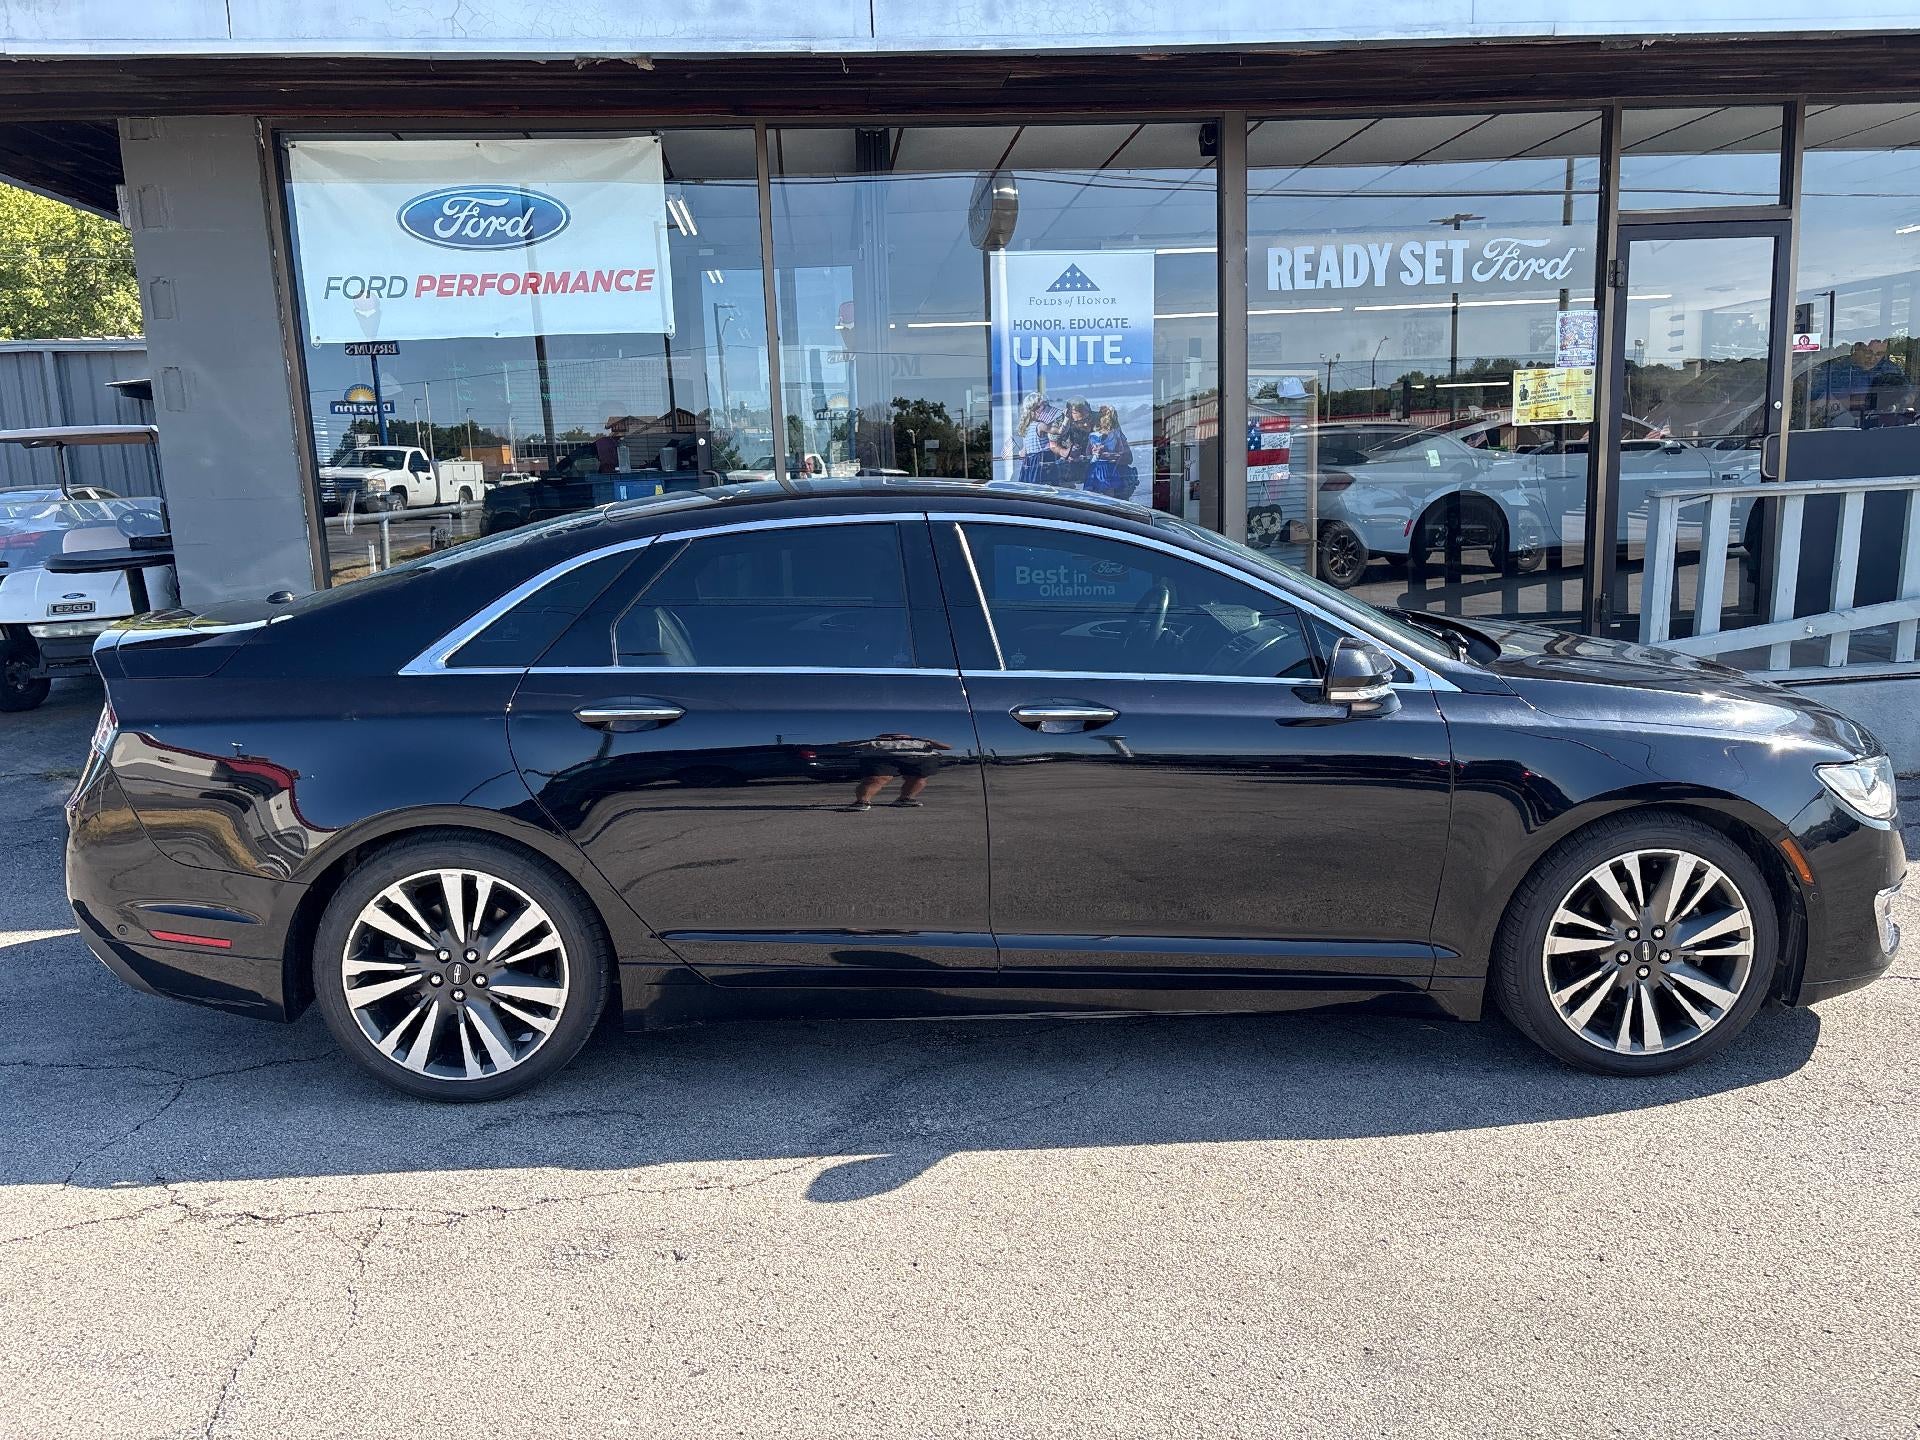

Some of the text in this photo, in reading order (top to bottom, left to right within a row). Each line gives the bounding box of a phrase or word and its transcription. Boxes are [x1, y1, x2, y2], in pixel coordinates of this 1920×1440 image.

[433, 196, 535, 238] Ford
[1266, 237, 1577, 291] READY SET Ford
[323, 268, 656, 300] FORD PERFORMANCE
[1065, 296, 1075, 308] of
[1013, 318, 1131, 330] HONOR. EDUCATE.
[1013, 334, 1132, 367] UNITE.
[1015, 565, 1087, 585] Best in
[1097, 562, 1124, 574] Ford
[1039, 584, 1116, 597] Oklahoma
